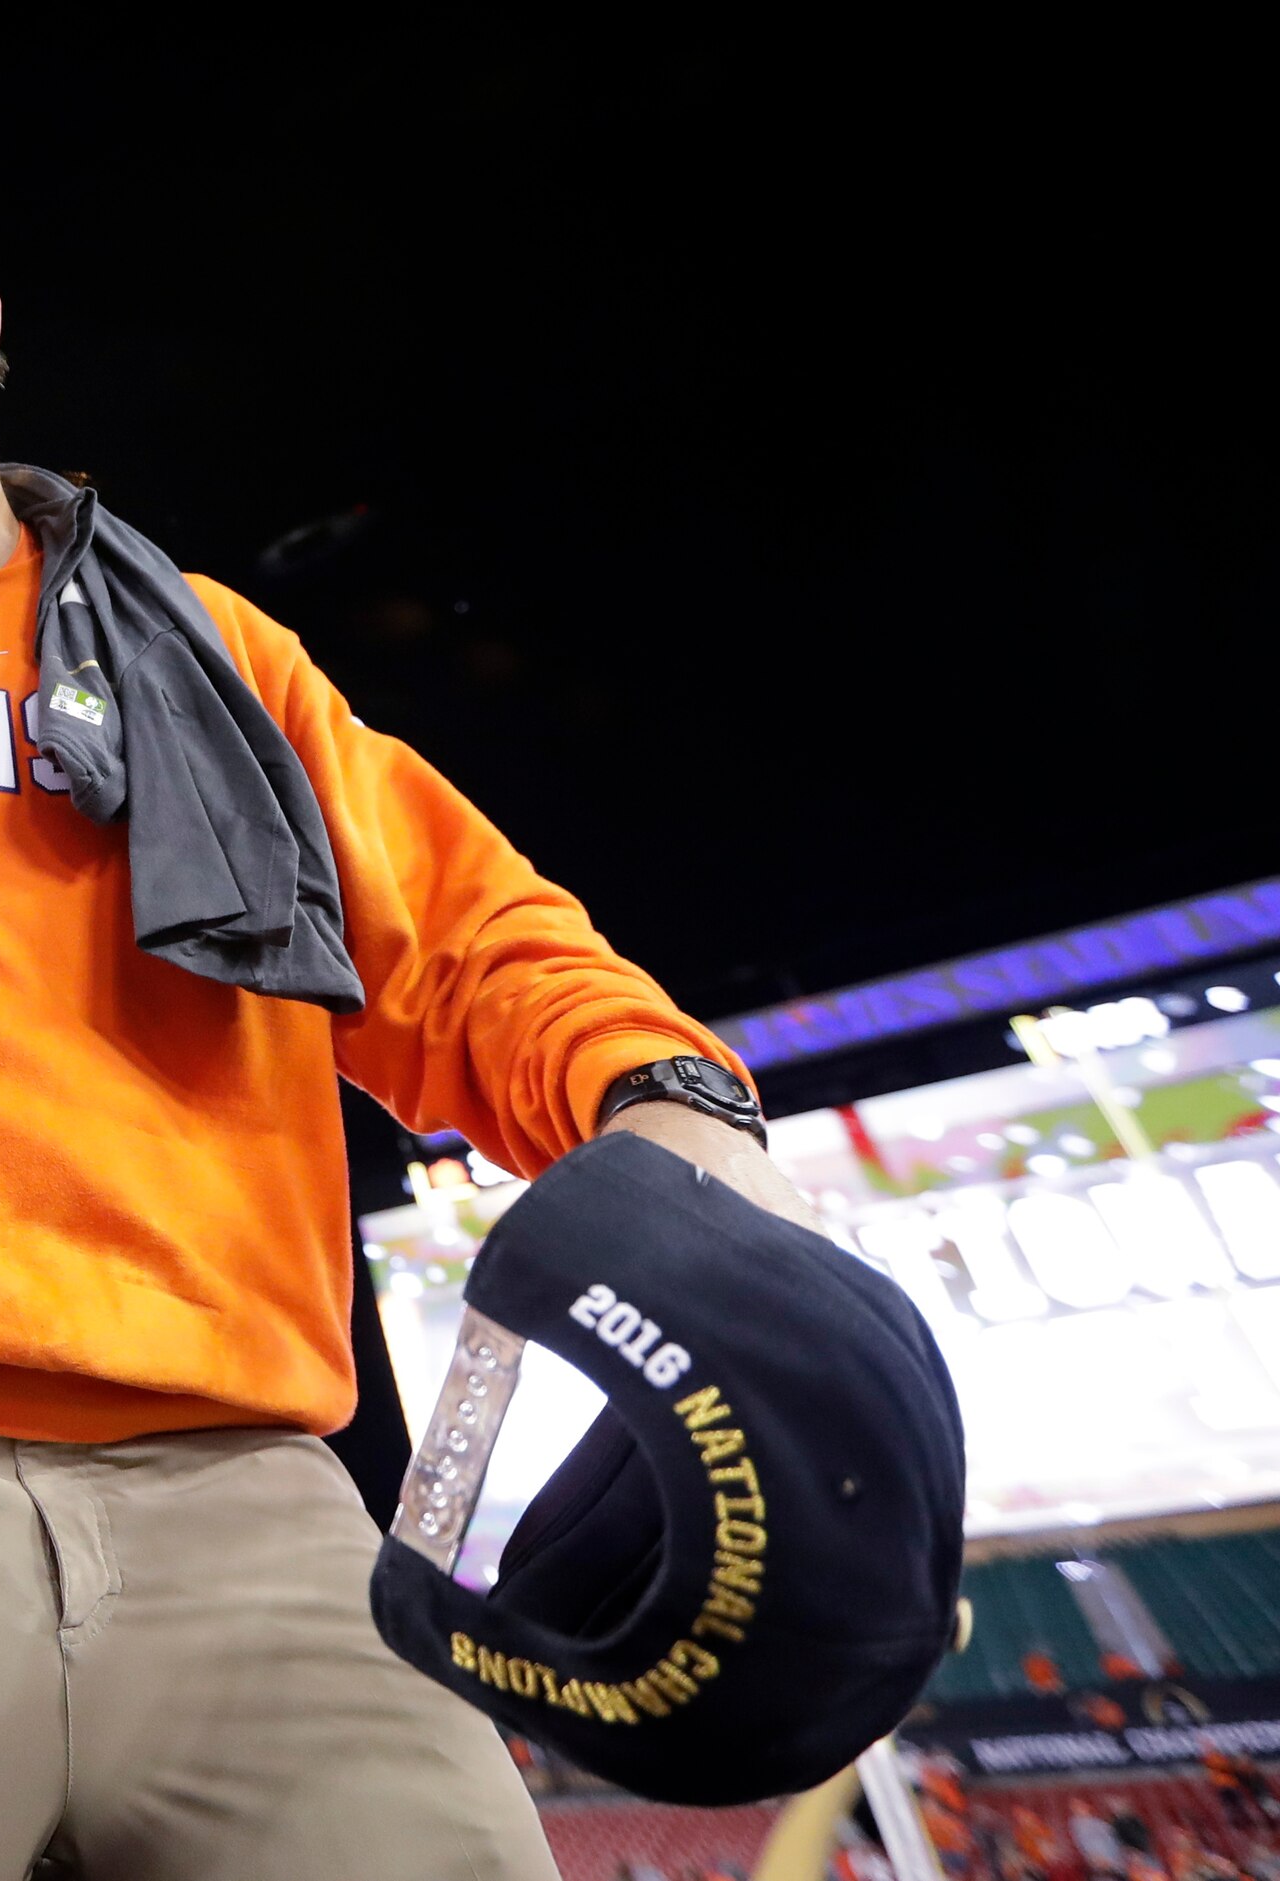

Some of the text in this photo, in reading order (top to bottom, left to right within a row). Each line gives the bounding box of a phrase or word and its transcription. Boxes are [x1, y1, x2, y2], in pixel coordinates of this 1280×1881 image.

[451, 1283, 768, 1725] 2016 NATIONAL CHAMPIONS
